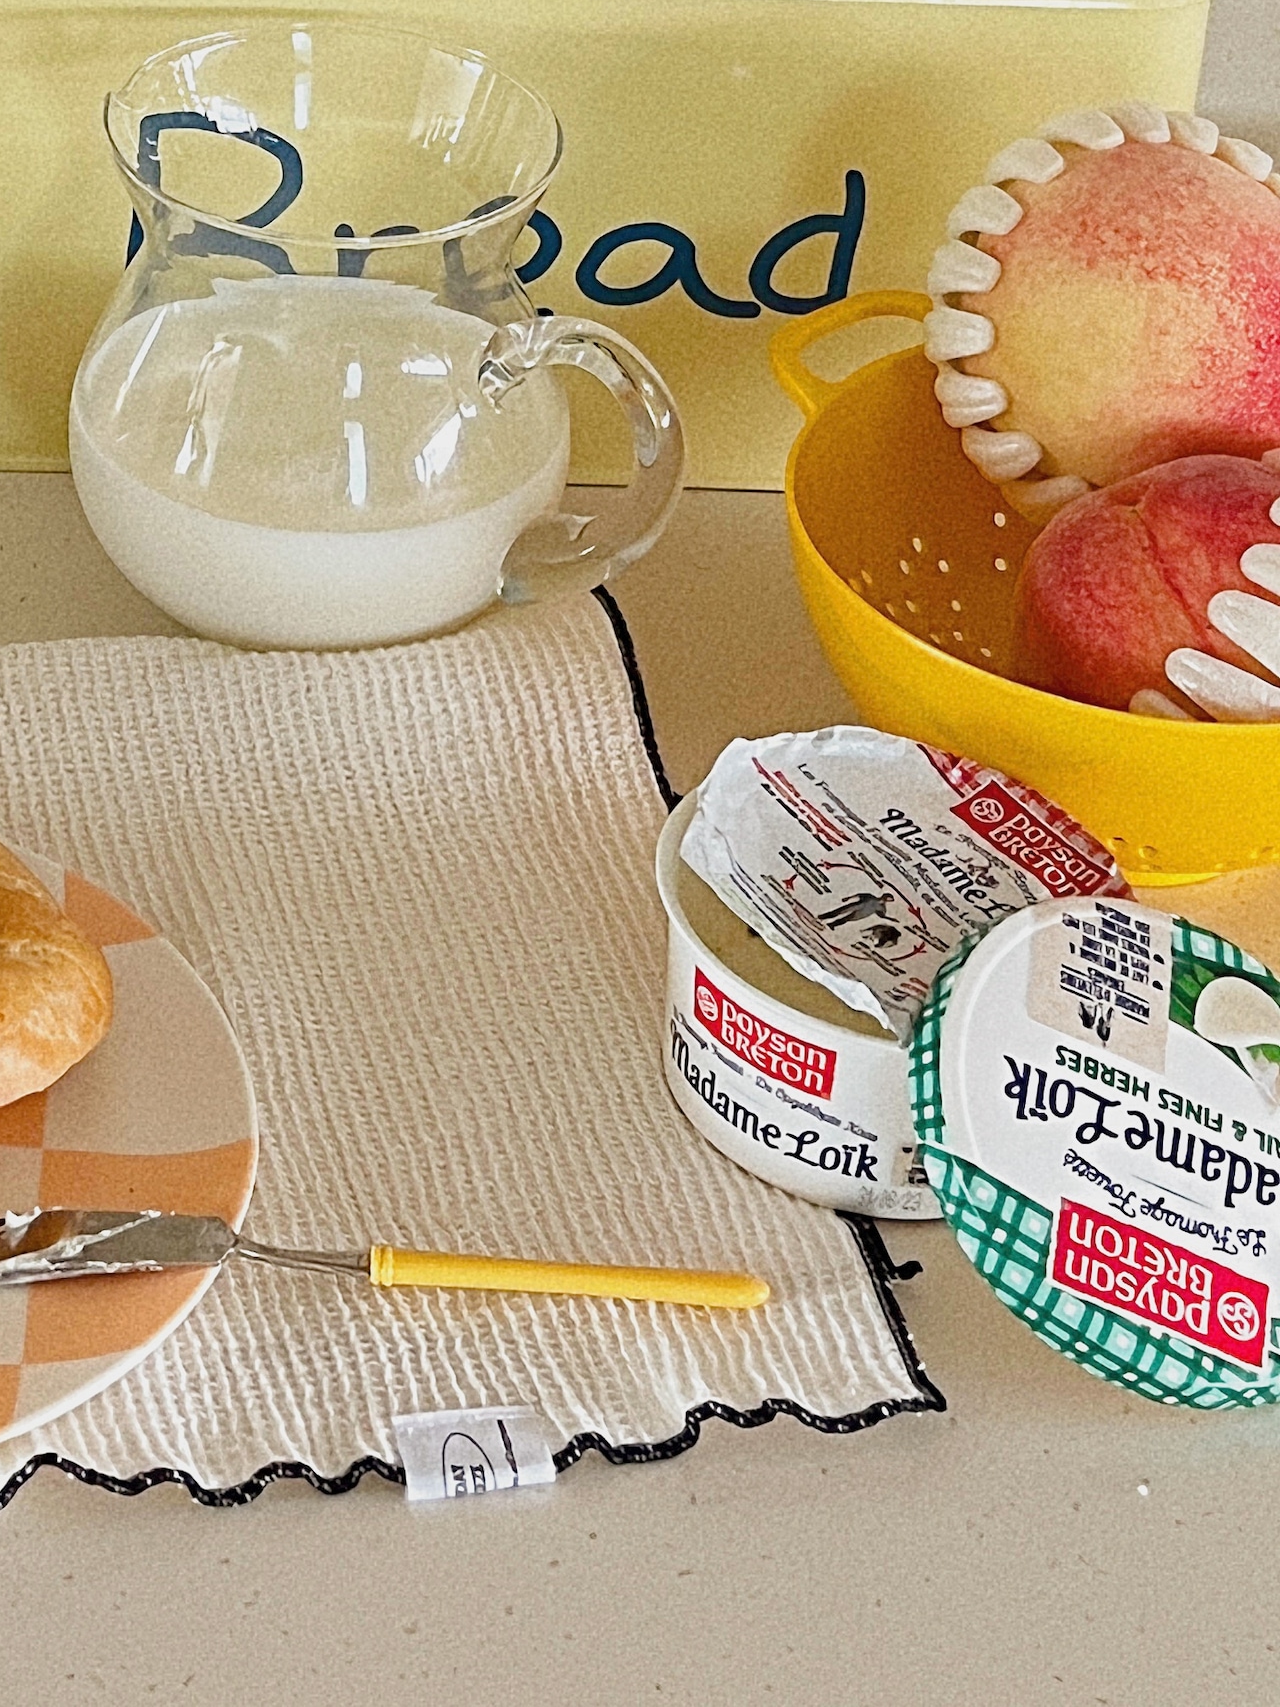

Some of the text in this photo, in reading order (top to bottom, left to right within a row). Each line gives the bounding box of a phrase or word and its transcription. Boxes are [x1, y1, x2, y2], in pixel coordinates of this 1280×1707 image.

[878, 807, 988, 905] Madame
[670, 1019, 782, 1150] Madame
[783, 1130, 880, 1183] Loïk
[1055, 1044, 1151, 1101] HERBES
[1002, 1054, 1280, 1207] adame Loïk
[1157, 1087, 1224, 1135] FINES
[1232, 1119, 1249, 1143] &
[1139, 1202, 1241, 1255] Fromage
